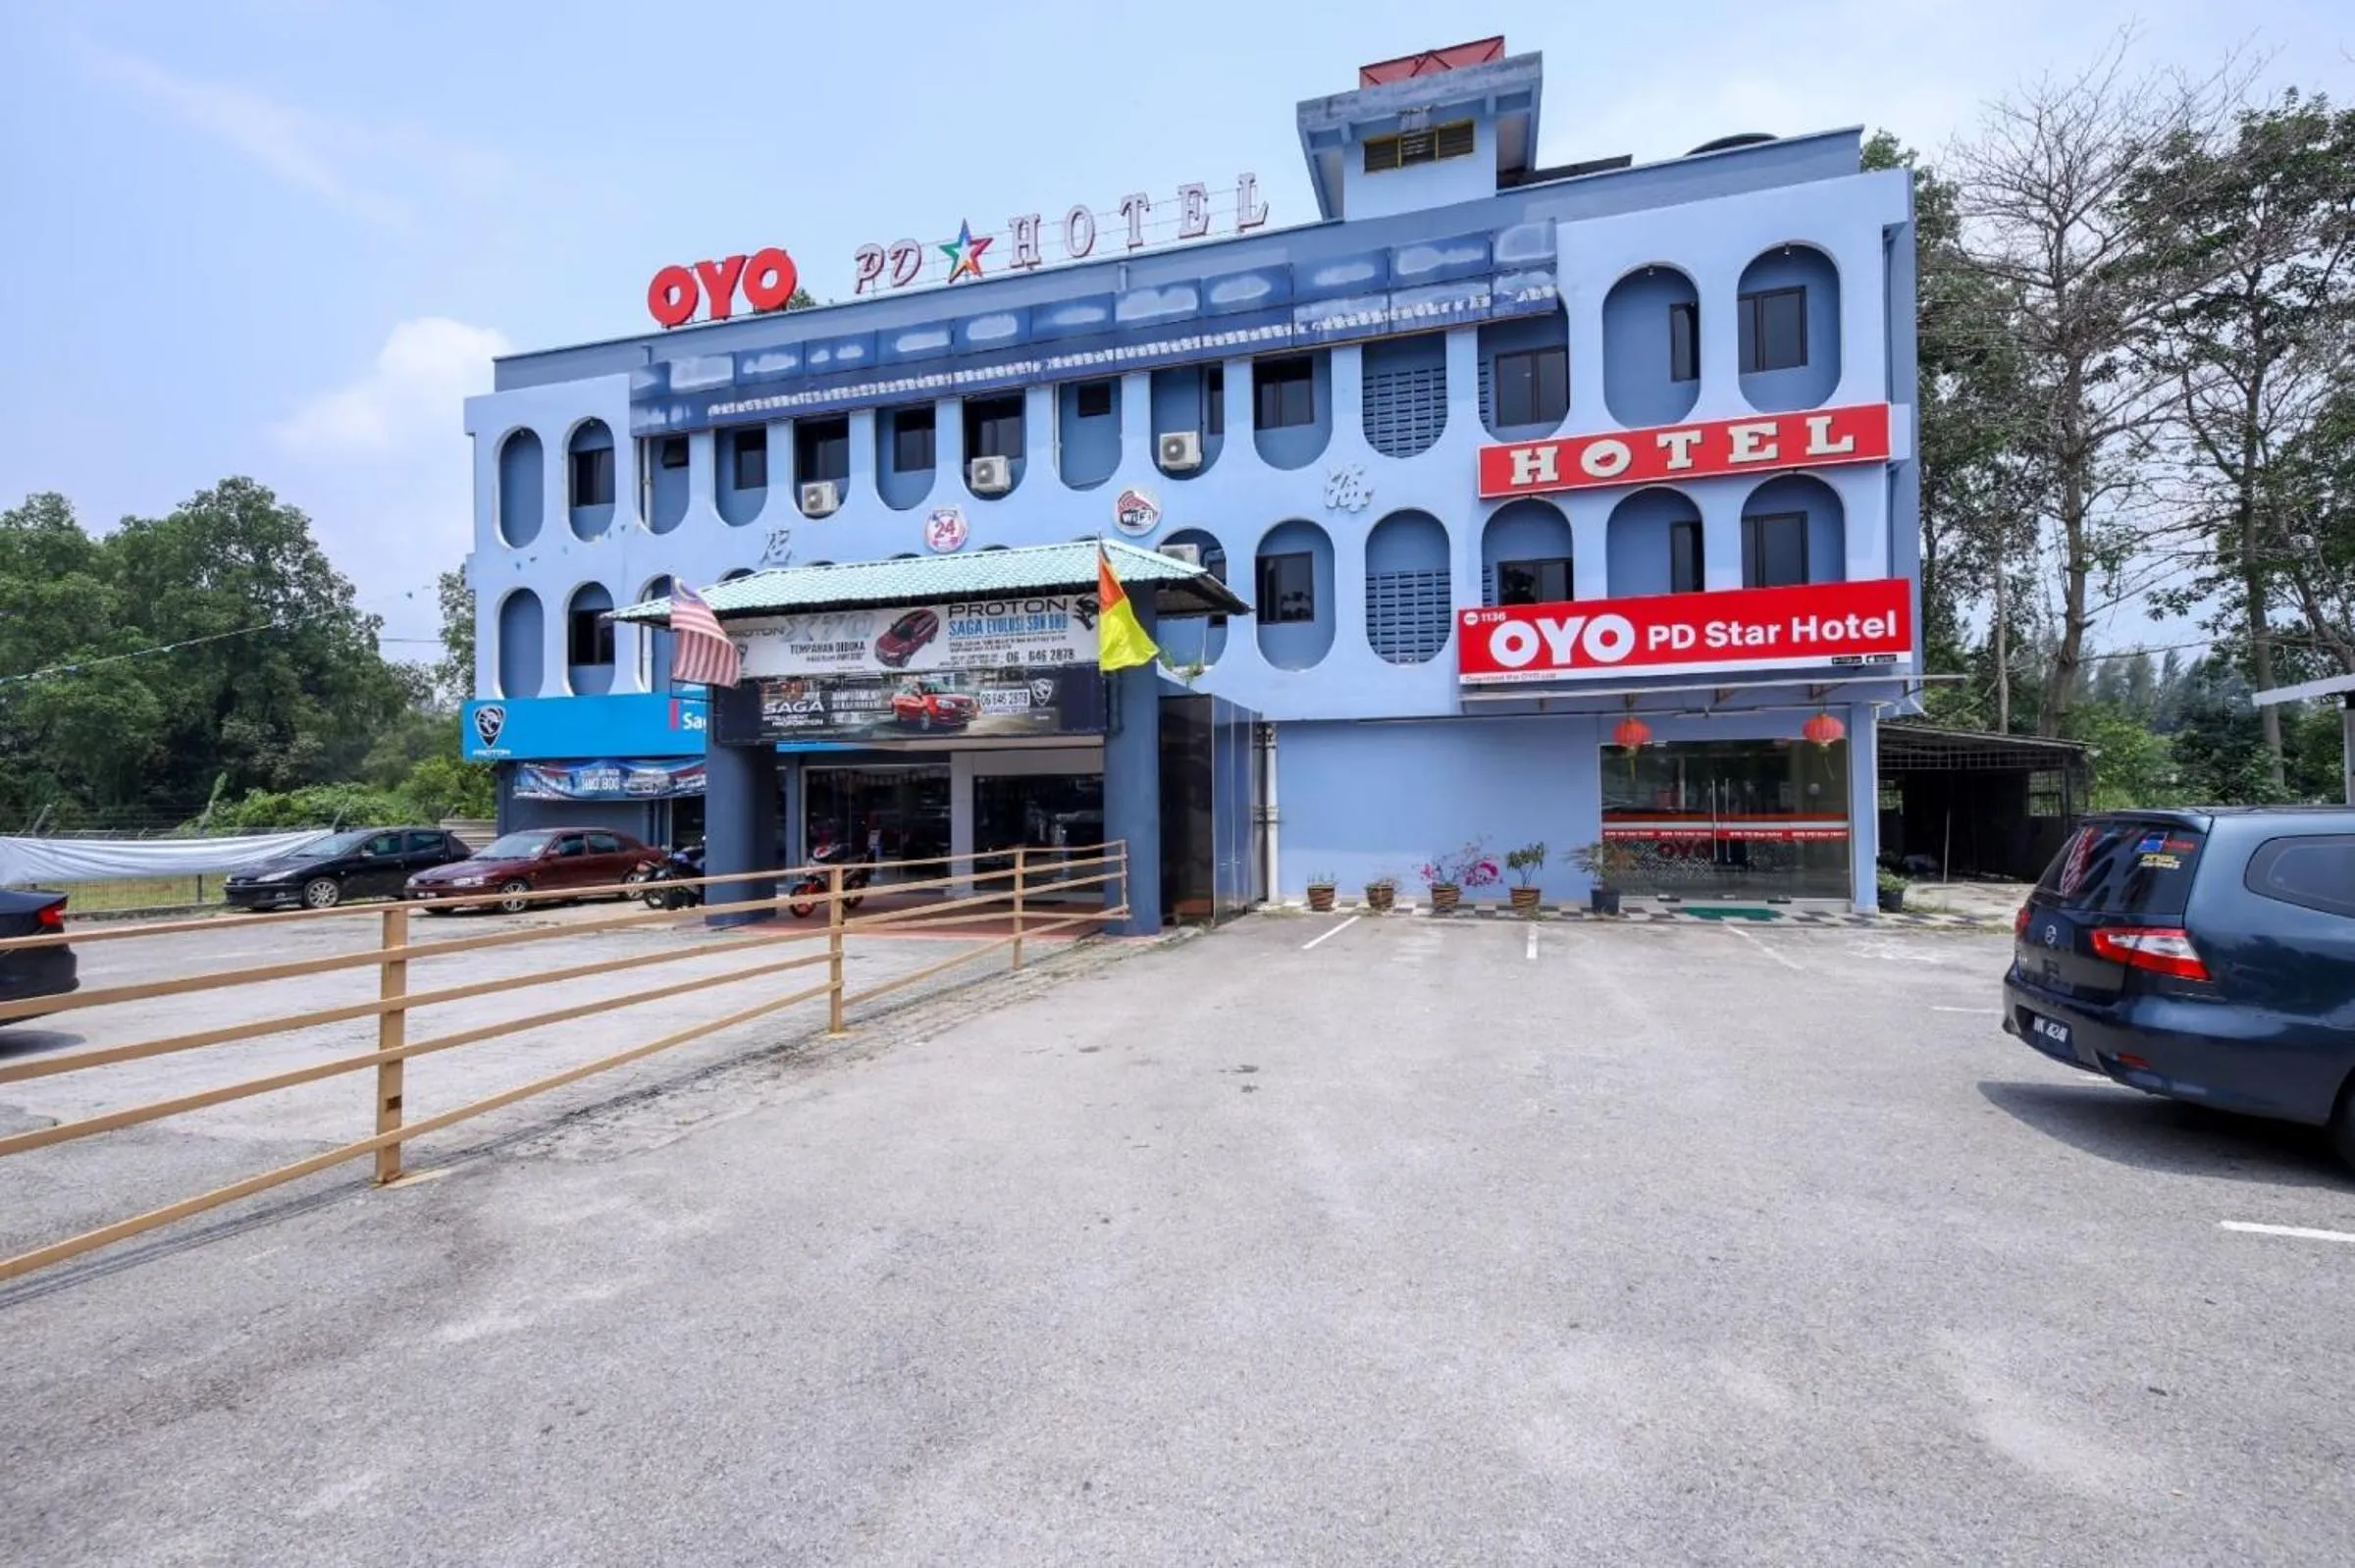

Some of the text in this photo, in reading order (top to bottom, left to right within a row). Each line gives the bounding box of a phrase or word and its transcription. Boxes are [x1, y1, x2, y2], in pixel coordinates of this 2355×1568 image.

[855, 172, 1270, 294] PD HOTEL
[648, 247, 798, 327] OYO
[1509, 416, 1855, 486] HOTEL
[934, 519, 956, 539] 24
[949, 599, 1068, 618] PROTON
[949, 618, 982, 637] SAGA
[1490, 609, 1897, 667] OYO PD Star Hotel
[763, 701, 824, 713] SAGA
